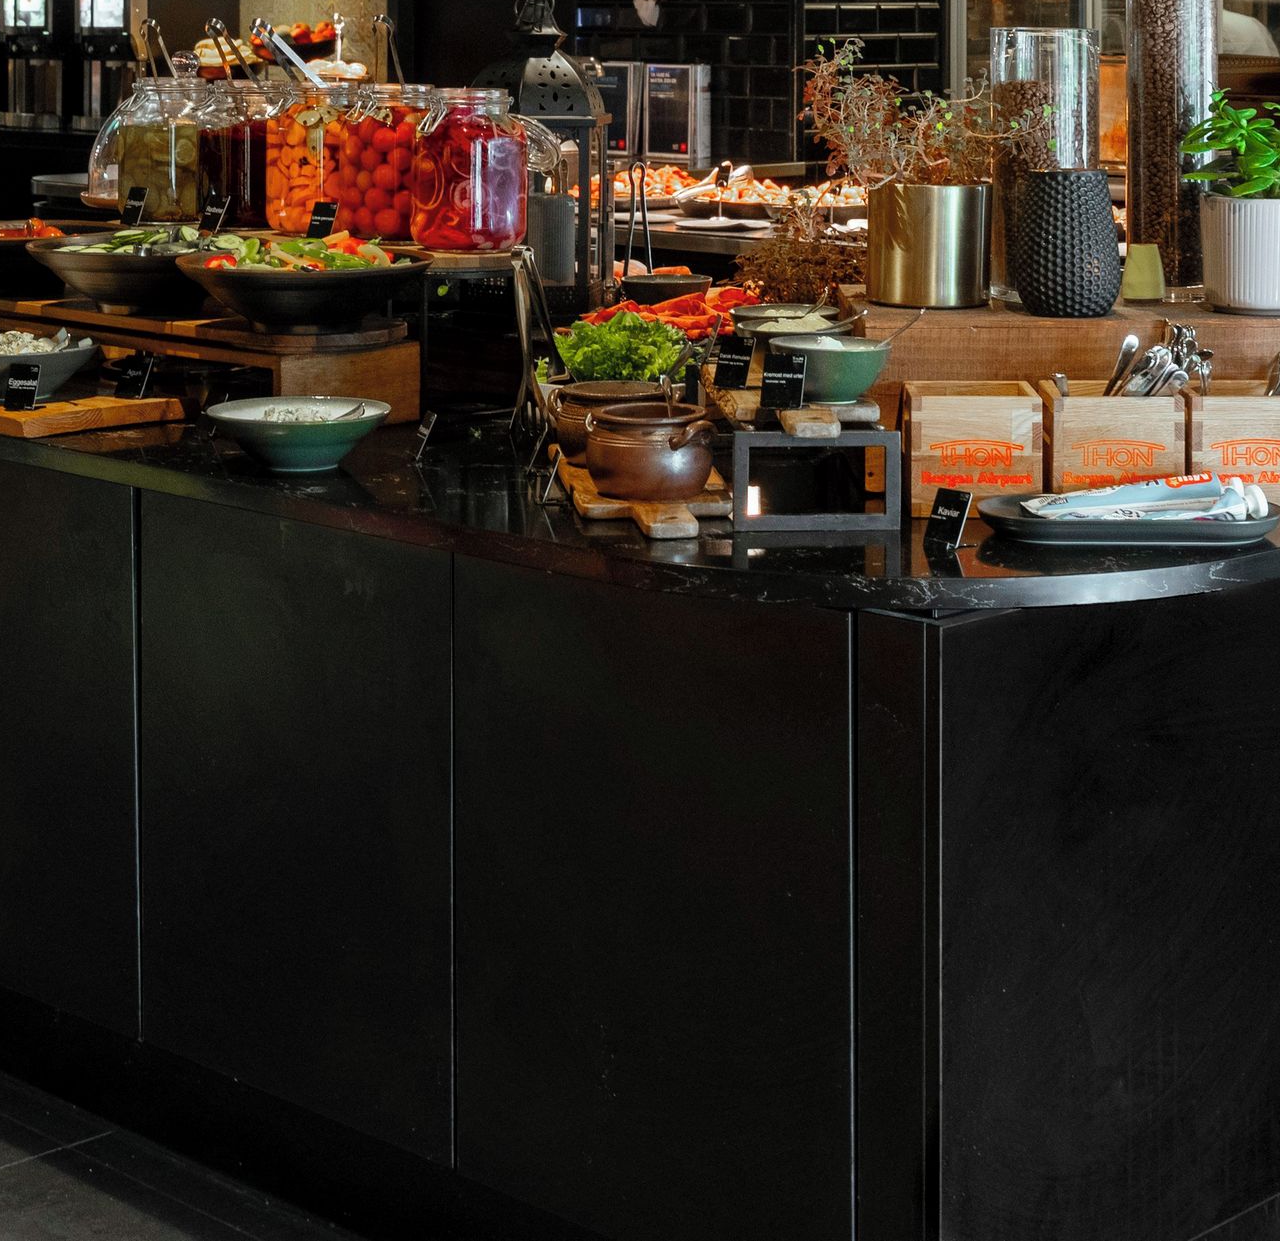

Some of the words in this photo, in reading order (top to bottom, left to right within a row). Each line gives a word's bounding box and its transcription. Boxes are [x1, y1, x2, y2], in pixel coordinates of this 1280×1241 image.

[930, 439, 1024, 467] THON
[1072, 439, 1166, 467] THON
[922, 472, 973, 487] Bergen
[978, 472, 1032, 487] Airport
[1062, 471, 1115, 488] Bergen
[937, 506, 961, 518] Kaviar
